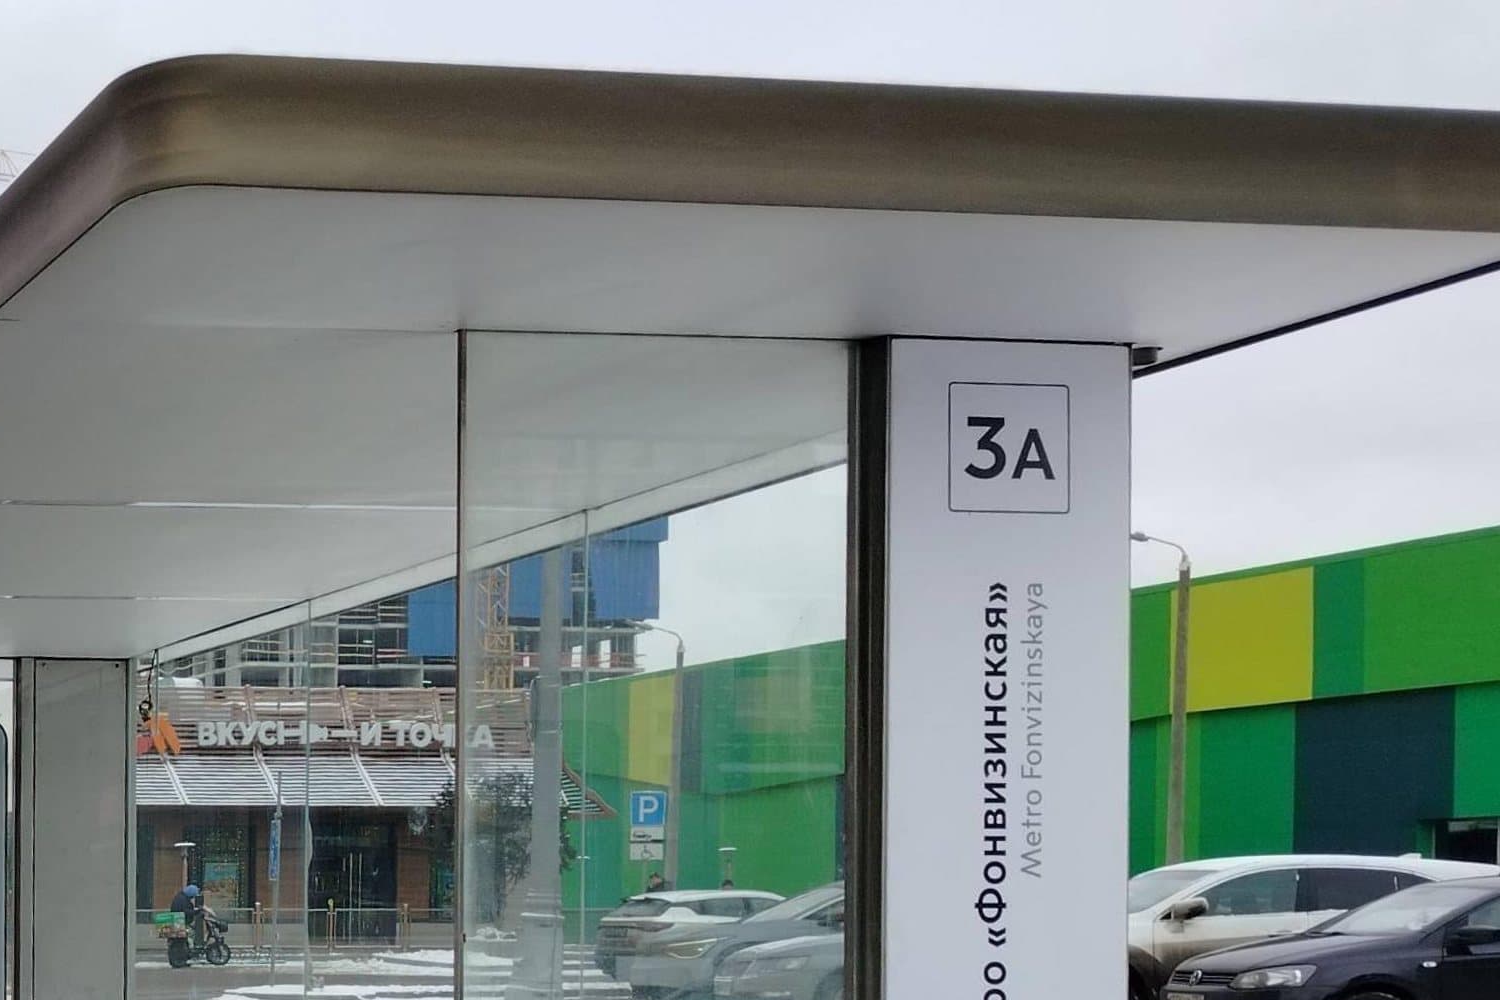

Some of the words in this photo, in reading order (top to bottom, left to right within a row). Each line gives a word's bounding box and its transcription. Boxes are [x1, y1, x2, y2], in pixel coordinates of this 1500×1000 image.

[964, 416, 1056, 480] 3А
[1020, 582, 1049, 779] Fonvizinskaya
[360, 722, 382, 747] И
[396, 722, 495, 749] ТОЧА
[975, 582, 1008, 947] «Фонвизинская»
[638, 795, 659, 823] P
[1020, 788, 1043, 878] Metro
